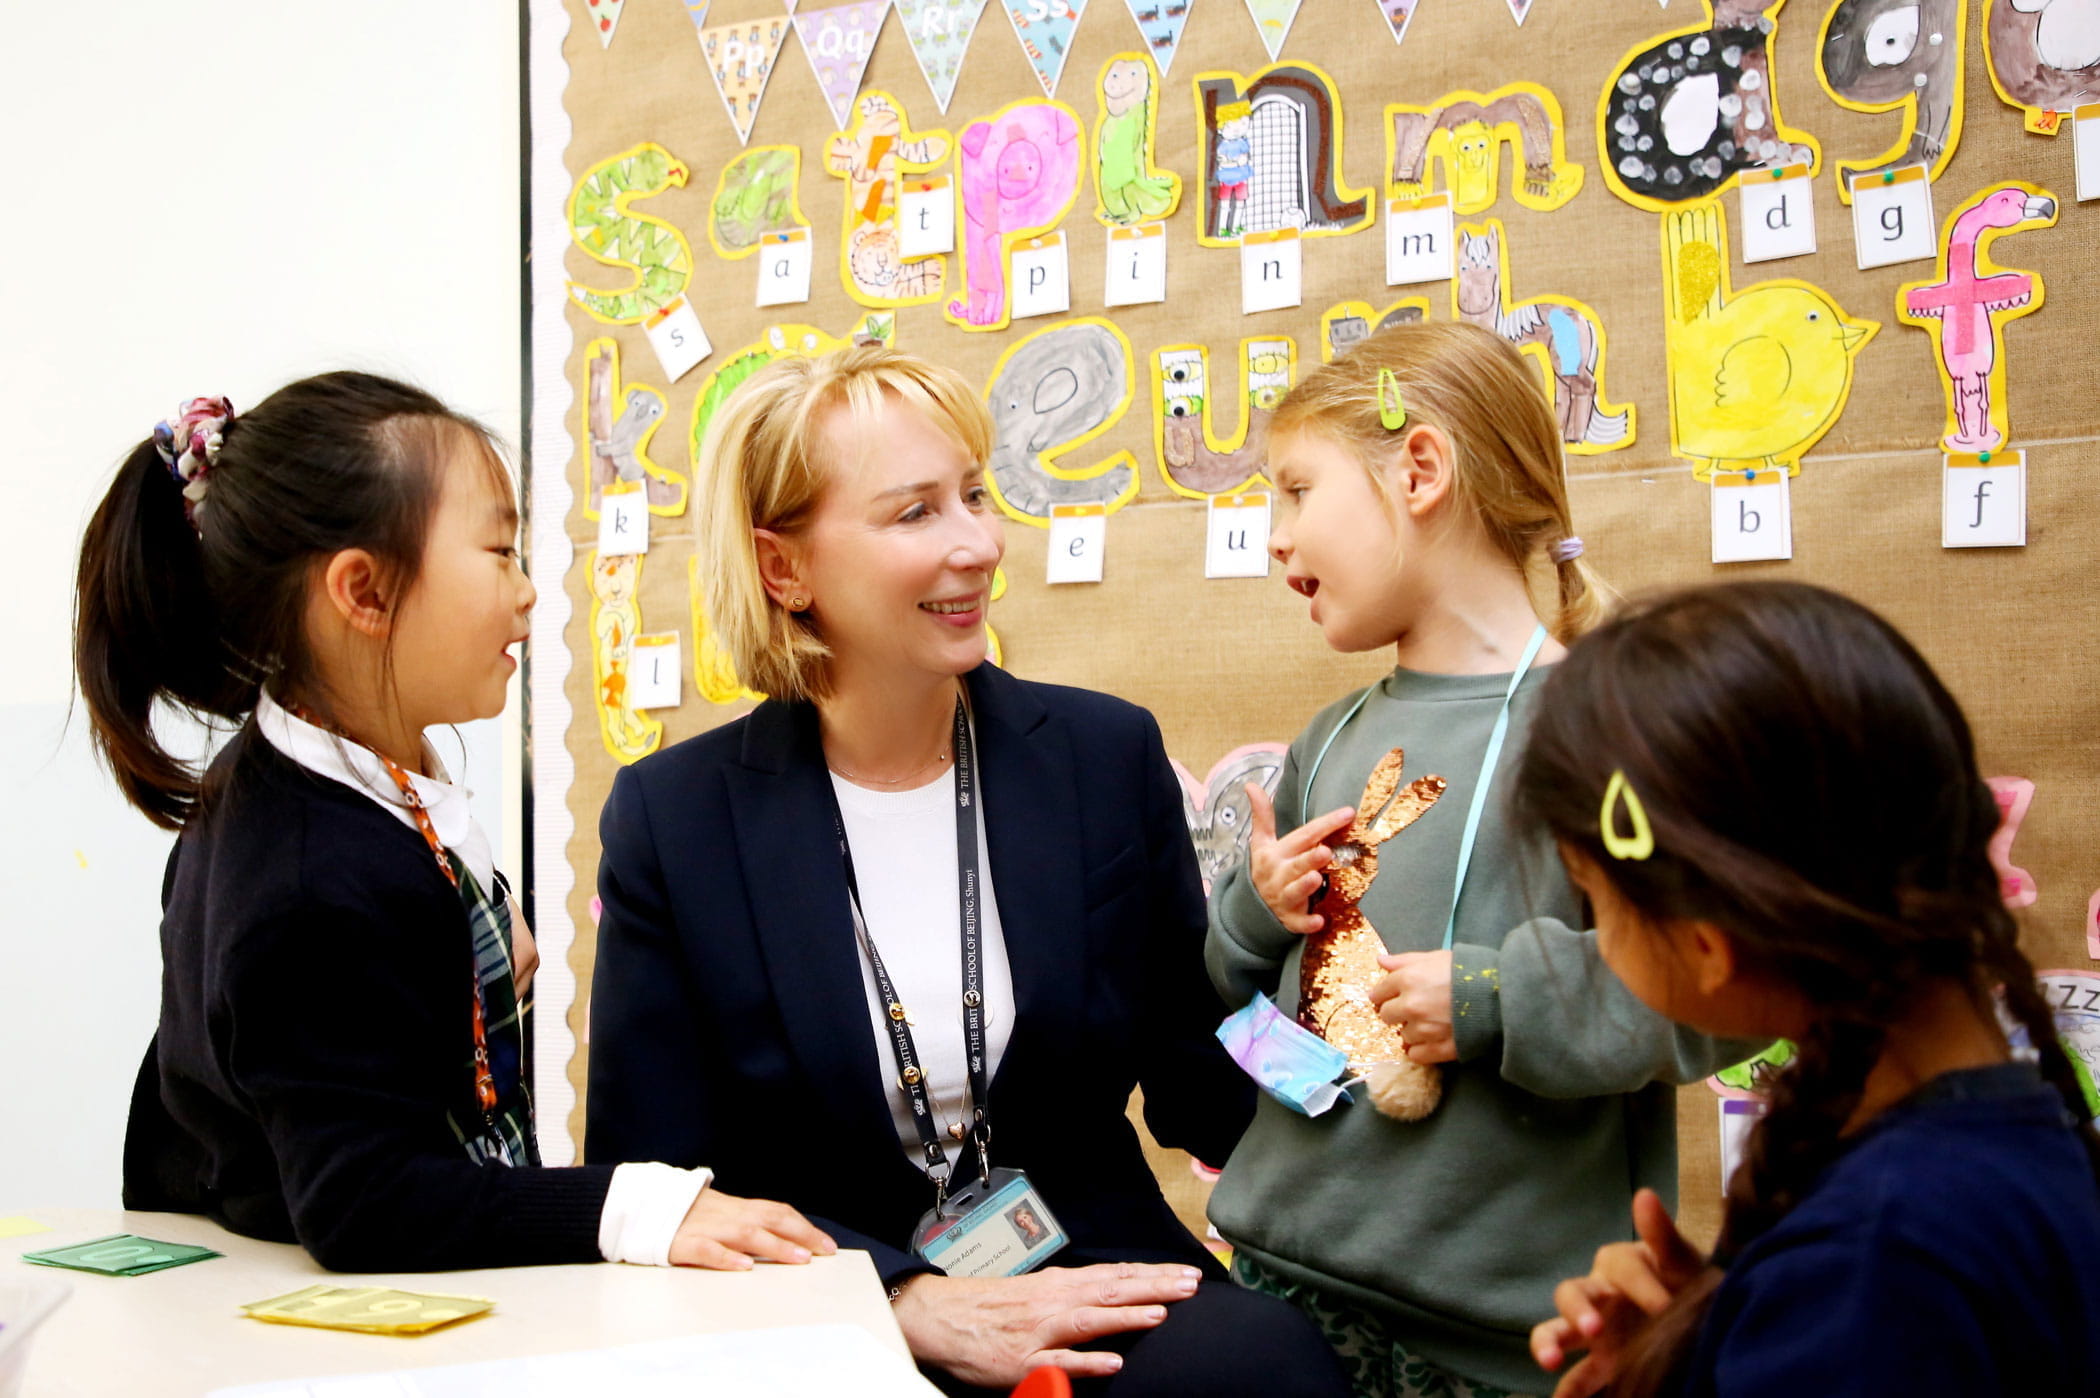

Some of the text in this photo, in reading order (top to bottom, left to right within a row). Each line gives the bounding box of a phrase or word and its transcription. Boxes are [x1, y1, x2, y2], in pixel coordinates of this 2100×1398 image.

[921, 5, 963, 37] Rr
[722, 40, 766, 78] Pp
[817, 26, 867, 62] Qq
[1193, 59, 1375, 247] n
[917, 205, 931, 232] t
[944, 97, 1085, 332] p
[1764, 193, 1792, 231] d
[1879, 204, 1905, 243] g
[566, 143, 690, 323] s
[1402, 231, 1437, 258] m
[773, 258, 791, 279] a
[1028, 263, 1046, 295] p
[1131, 251, 1139, 281] i
[1262, 259, 1283, 282] n
[669, 327, 686, 348] s
[1738, 498, 1762, 534] b
[1968, 479, 1994, 529] f
[615, 511, 628, 535] k
[1069, 536, 1086, 558] e
[1226, 528, 1248, 552] u
[653, 656, 661, 687] l
[958, 735, 968, 769] BRITISH
[960, 770, 969, 789] THE
[965, 869, 976, 898] Shunyi
[967, 934, 976, 948] OF
[967, 949, 978, 990] SCHOOL
[970, 1006, 979, 1028] BRIT
[896, 1033, 912, 1068] RITISH
[971, 1030, 980, 1051] THE
[961, 1240, 983, 1260] Adams
[973, 1258, 995, 1276] Primary
[993, 1244, 1012, 1263] School
